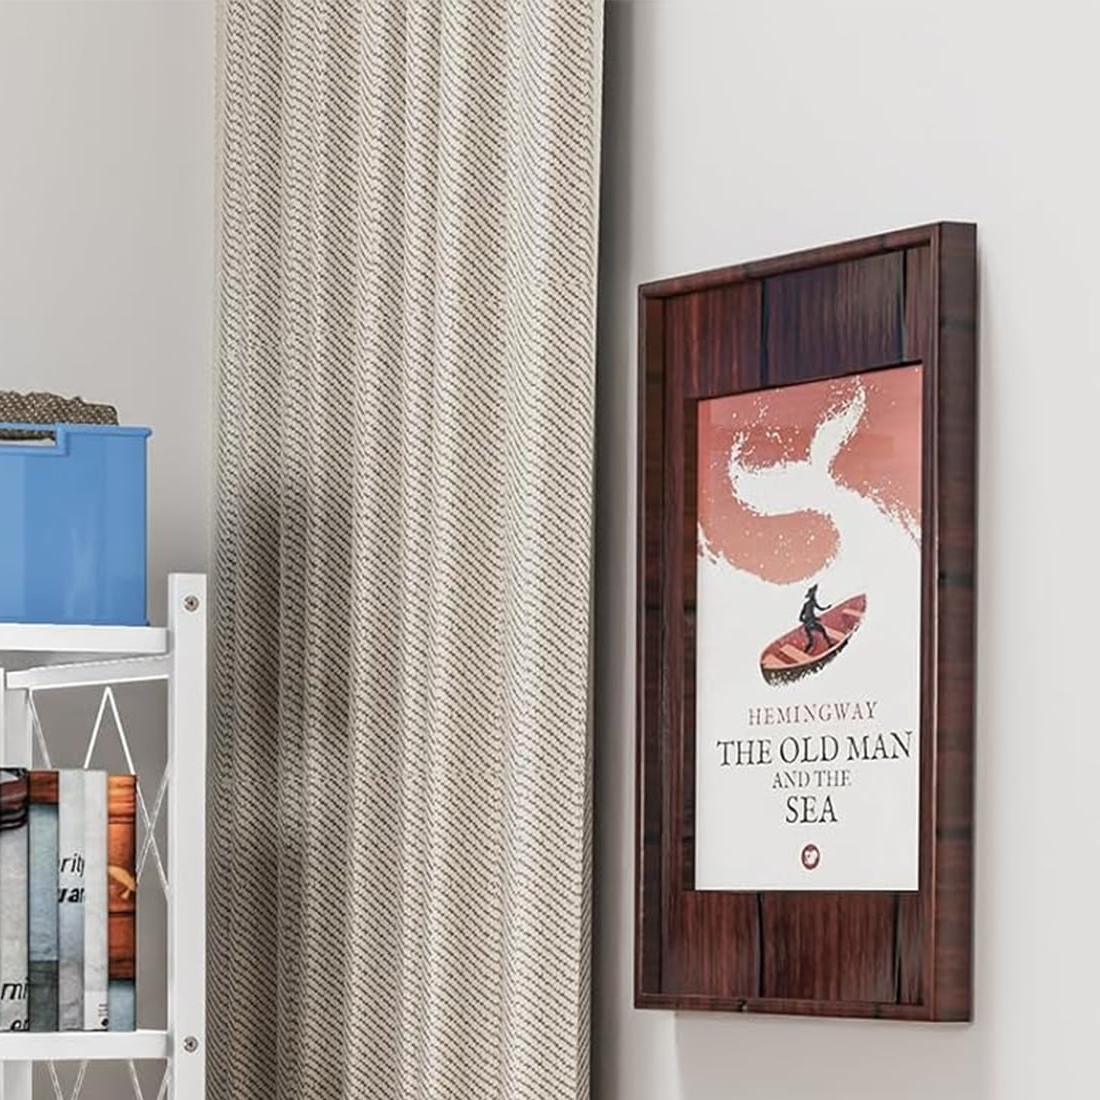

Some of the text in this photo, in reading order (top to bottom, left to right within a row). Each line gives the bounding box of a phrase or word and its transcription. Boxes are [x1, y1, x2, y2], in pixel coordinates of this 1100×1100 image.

[749, 701, 877, 726] HEMINGWAY
[717, 731, 912, 766] THE OLD MAN
[772, 769, 852, 789] AND THE
[785, 795, 838, 823] SEA
